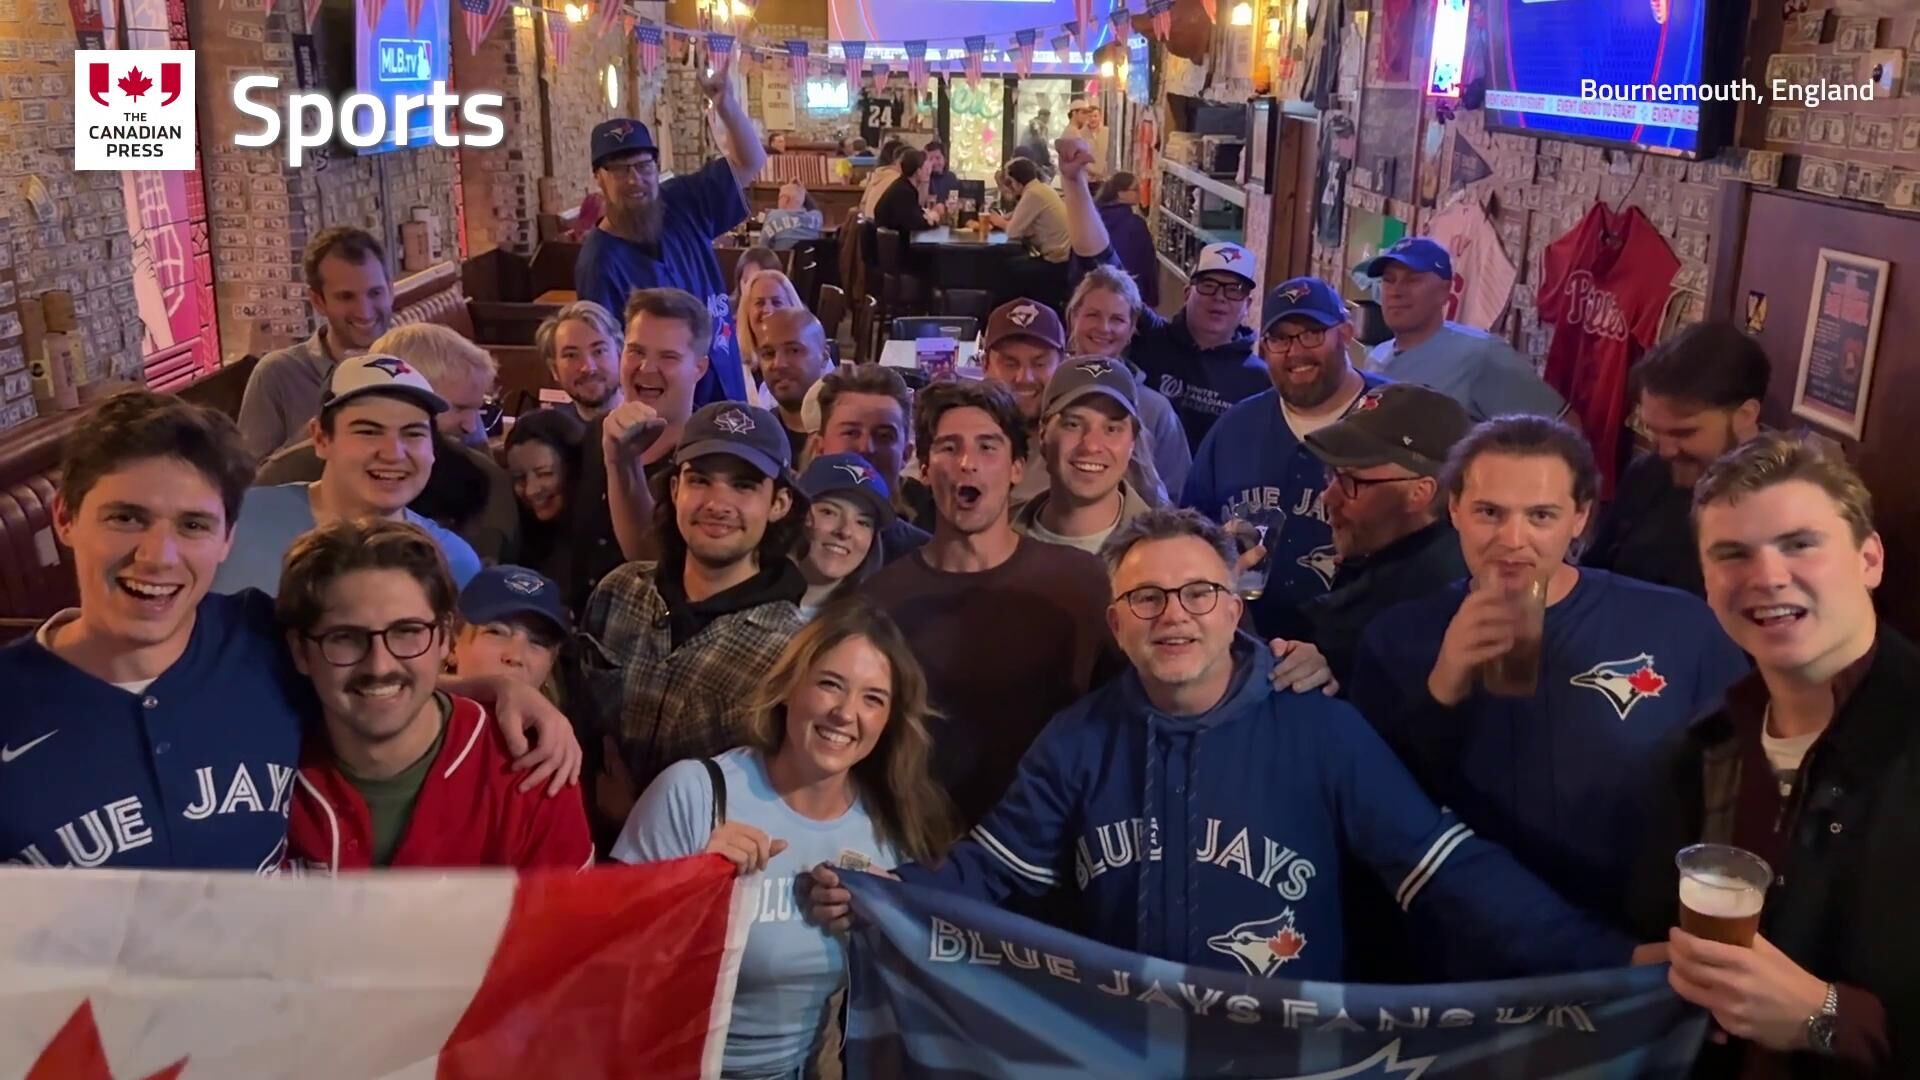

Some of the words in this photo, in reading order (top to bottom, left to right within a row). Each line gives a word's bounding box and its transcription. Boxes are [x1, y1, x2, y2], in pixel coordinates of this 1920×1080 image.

[867, 105, 893, 128] 24
[1556, 98, 1579, 113] EVENT
[1652, 106, 1680, 122] EVENT
[1221, 487, 1281, 520] UE
[15, 796, 153, 869] LUE
[182, 762, 293, 819] JAY
[1196, 818, 1317, 901] JAYS
[929, 915, 1081, 983] BLUE
[1096, 970, 1264, 1024] JAYS
